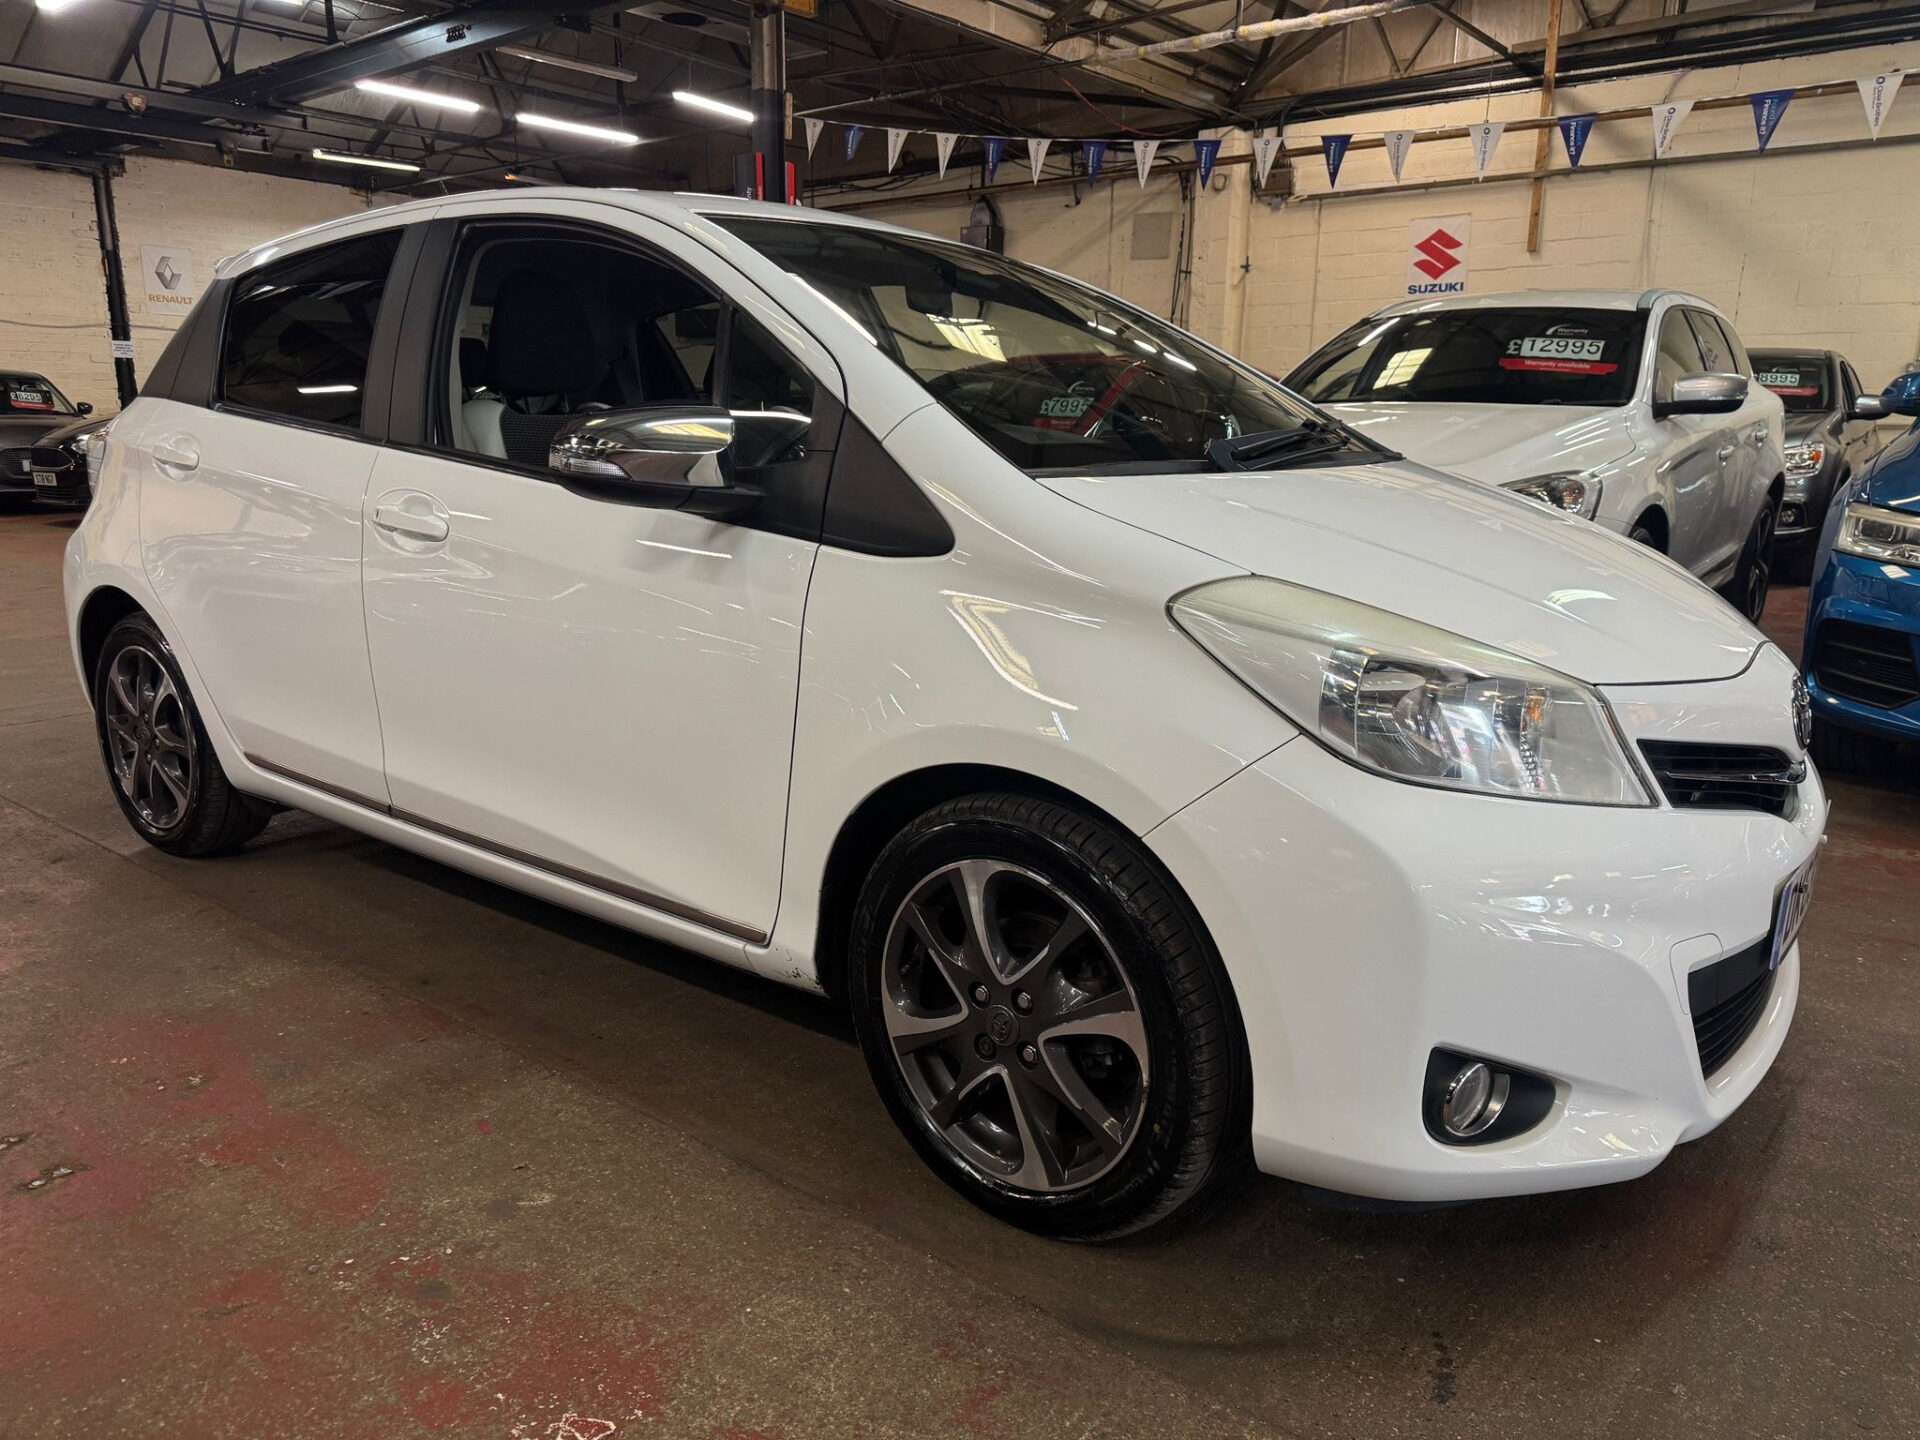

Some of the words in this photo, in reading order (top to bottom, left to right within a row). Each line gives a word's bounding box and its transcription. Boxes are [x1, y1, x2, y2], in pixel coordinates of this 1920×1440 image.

[1408, 282, 1464, 295] SUZUKI
[149, 294, 192, 304] RENAULT
[1506, 338, 1601, 355] £12995
[1756, 374, 1798, 384] 8995
